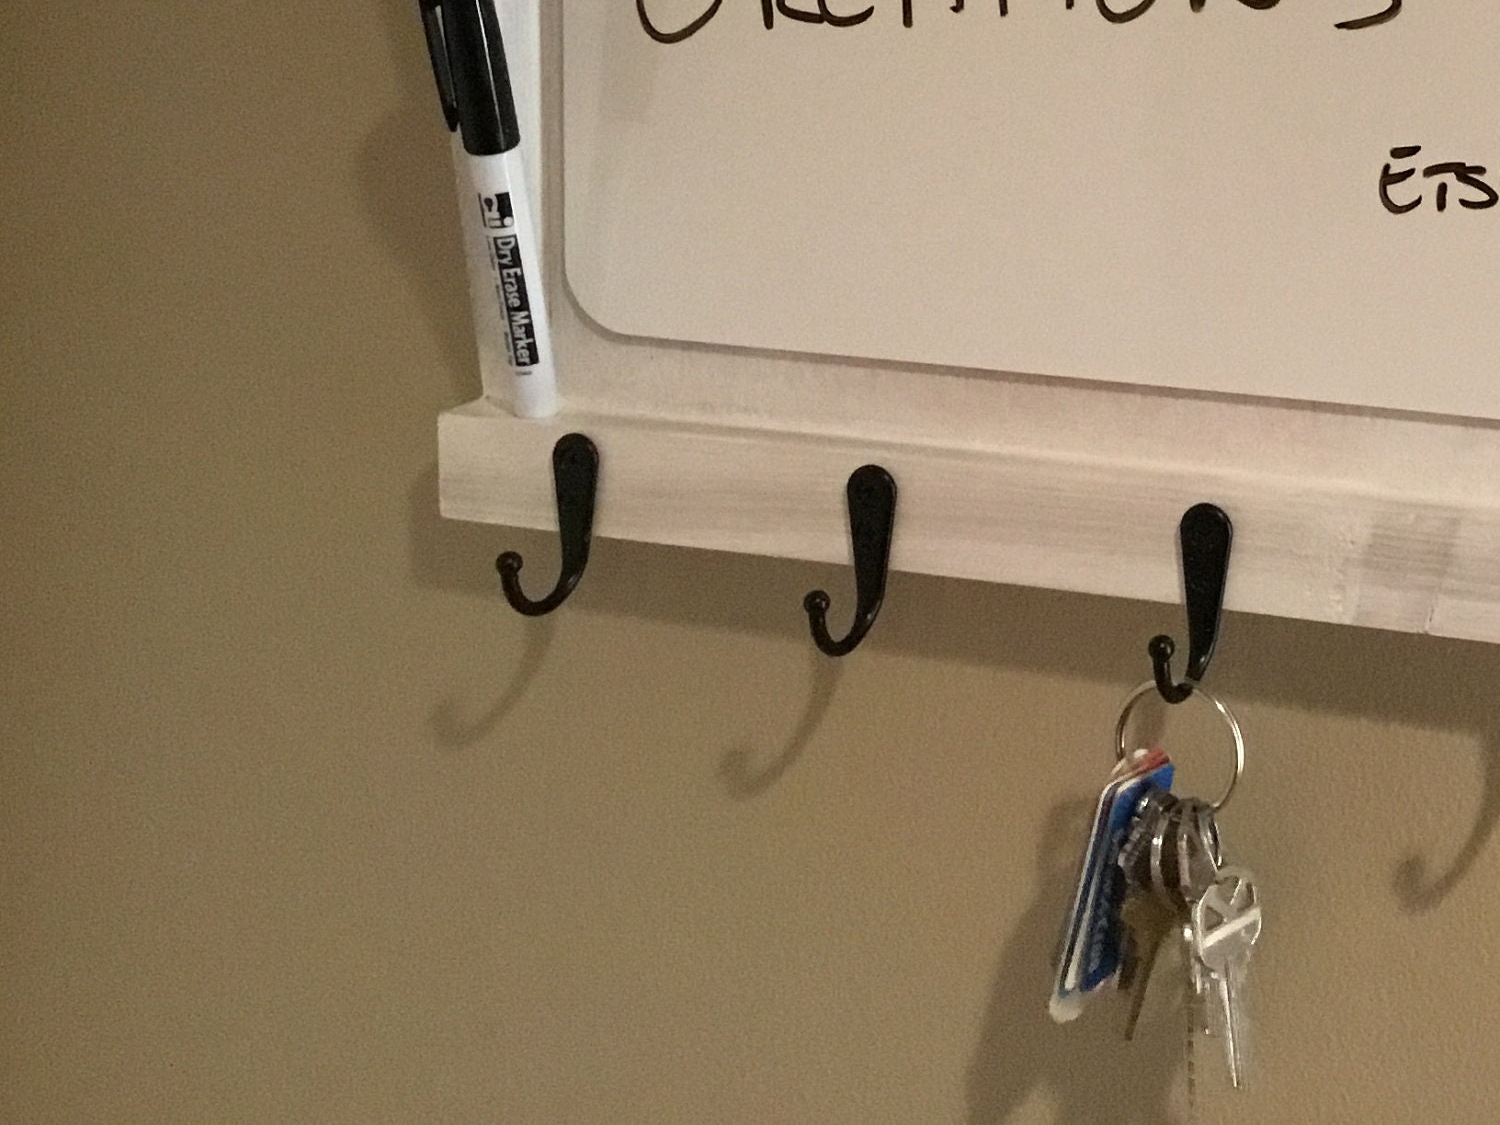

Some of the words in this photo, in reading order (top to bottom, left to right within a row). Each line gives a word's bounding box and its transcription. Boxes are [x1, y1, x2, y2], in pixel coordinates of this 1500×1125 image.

[496, 237, 516, 265] Dry
[502, 267, 522, 308] Erase
[510, 310, 534, 365] Marker
